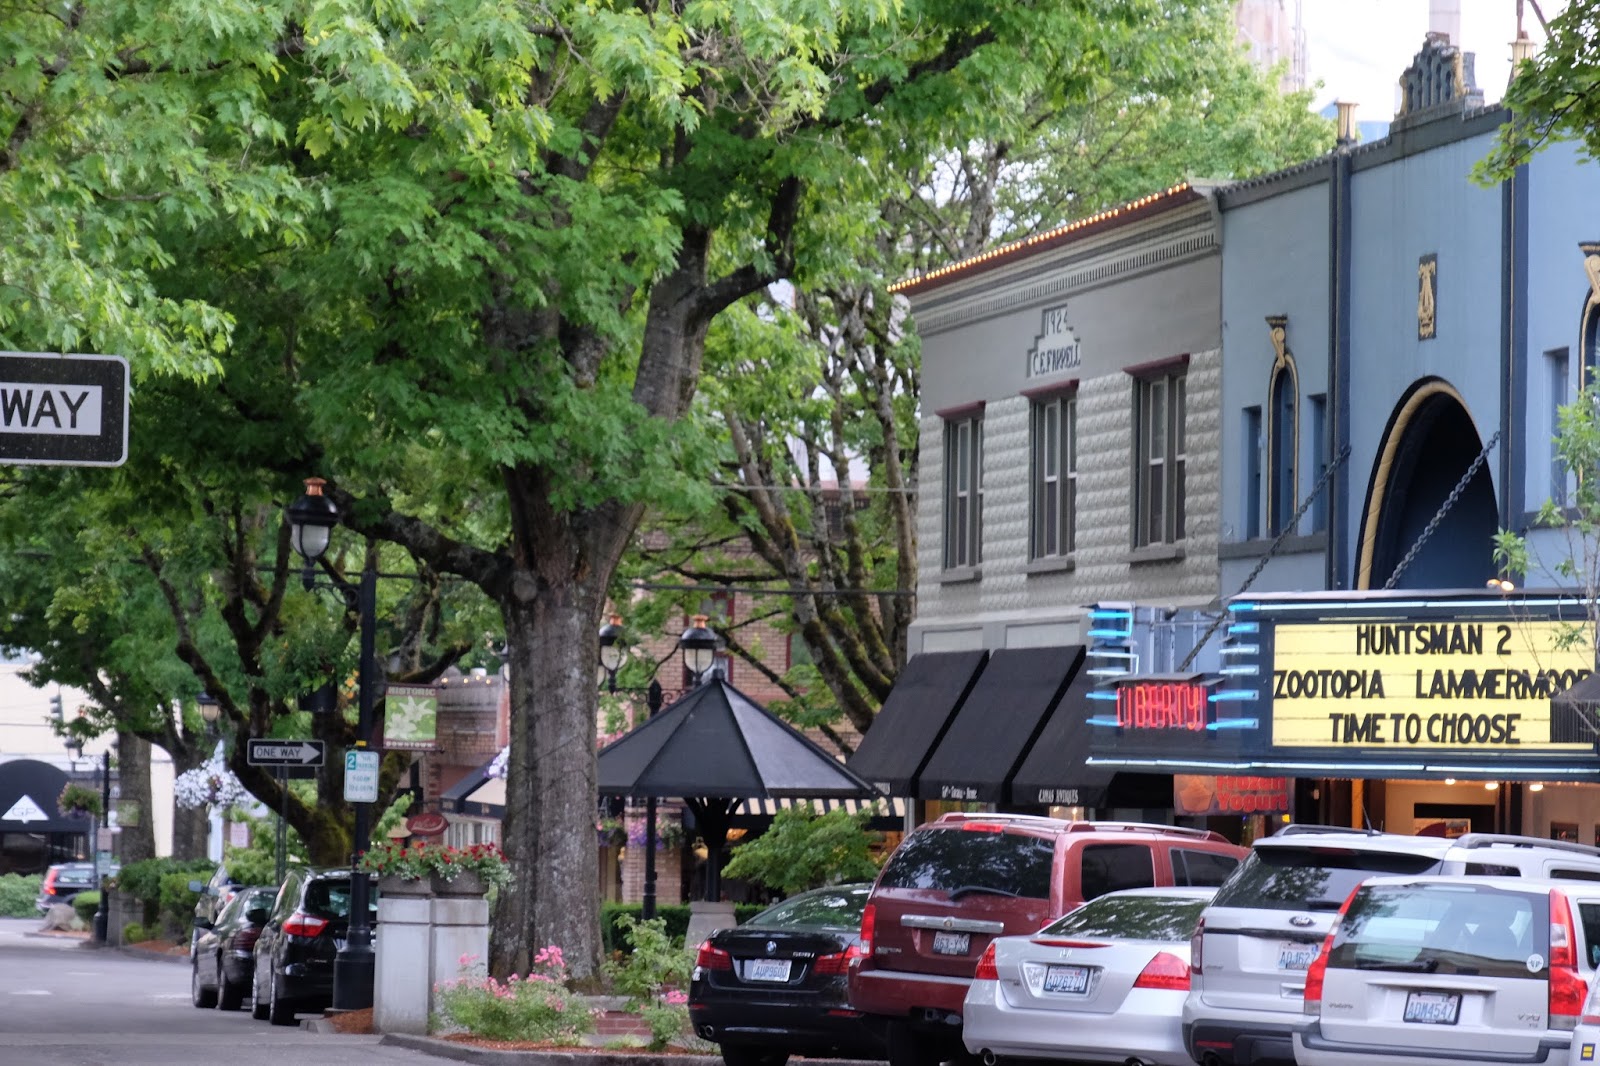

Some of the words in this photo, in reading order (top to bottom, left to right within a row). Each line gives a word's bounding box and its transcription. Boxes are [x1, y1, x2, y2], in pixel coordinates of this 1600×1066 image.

[0, 388, 90, 429] WAY
[1356, 624, 1483, 655] HUNTSMAN
[1496, 625, 1512, 655] 2
[388, 687, 436, 696] HISTORIC
[1273, 669, 1386, 699] ZOOTOPIA
[1116, 684, 1203, 730] LIBERTY
[1328, 713, 1386, 743] TIME
[1390, 713, 1422, 744] TO
[1426, 713, 1522, 744] CHOOSE
[256, 747, 277, 757] ONE
[280, 747, 301, 757] WAY
[348, 754, 356, 769] 2
[1216, 792, 1289, 813] Yogurt
